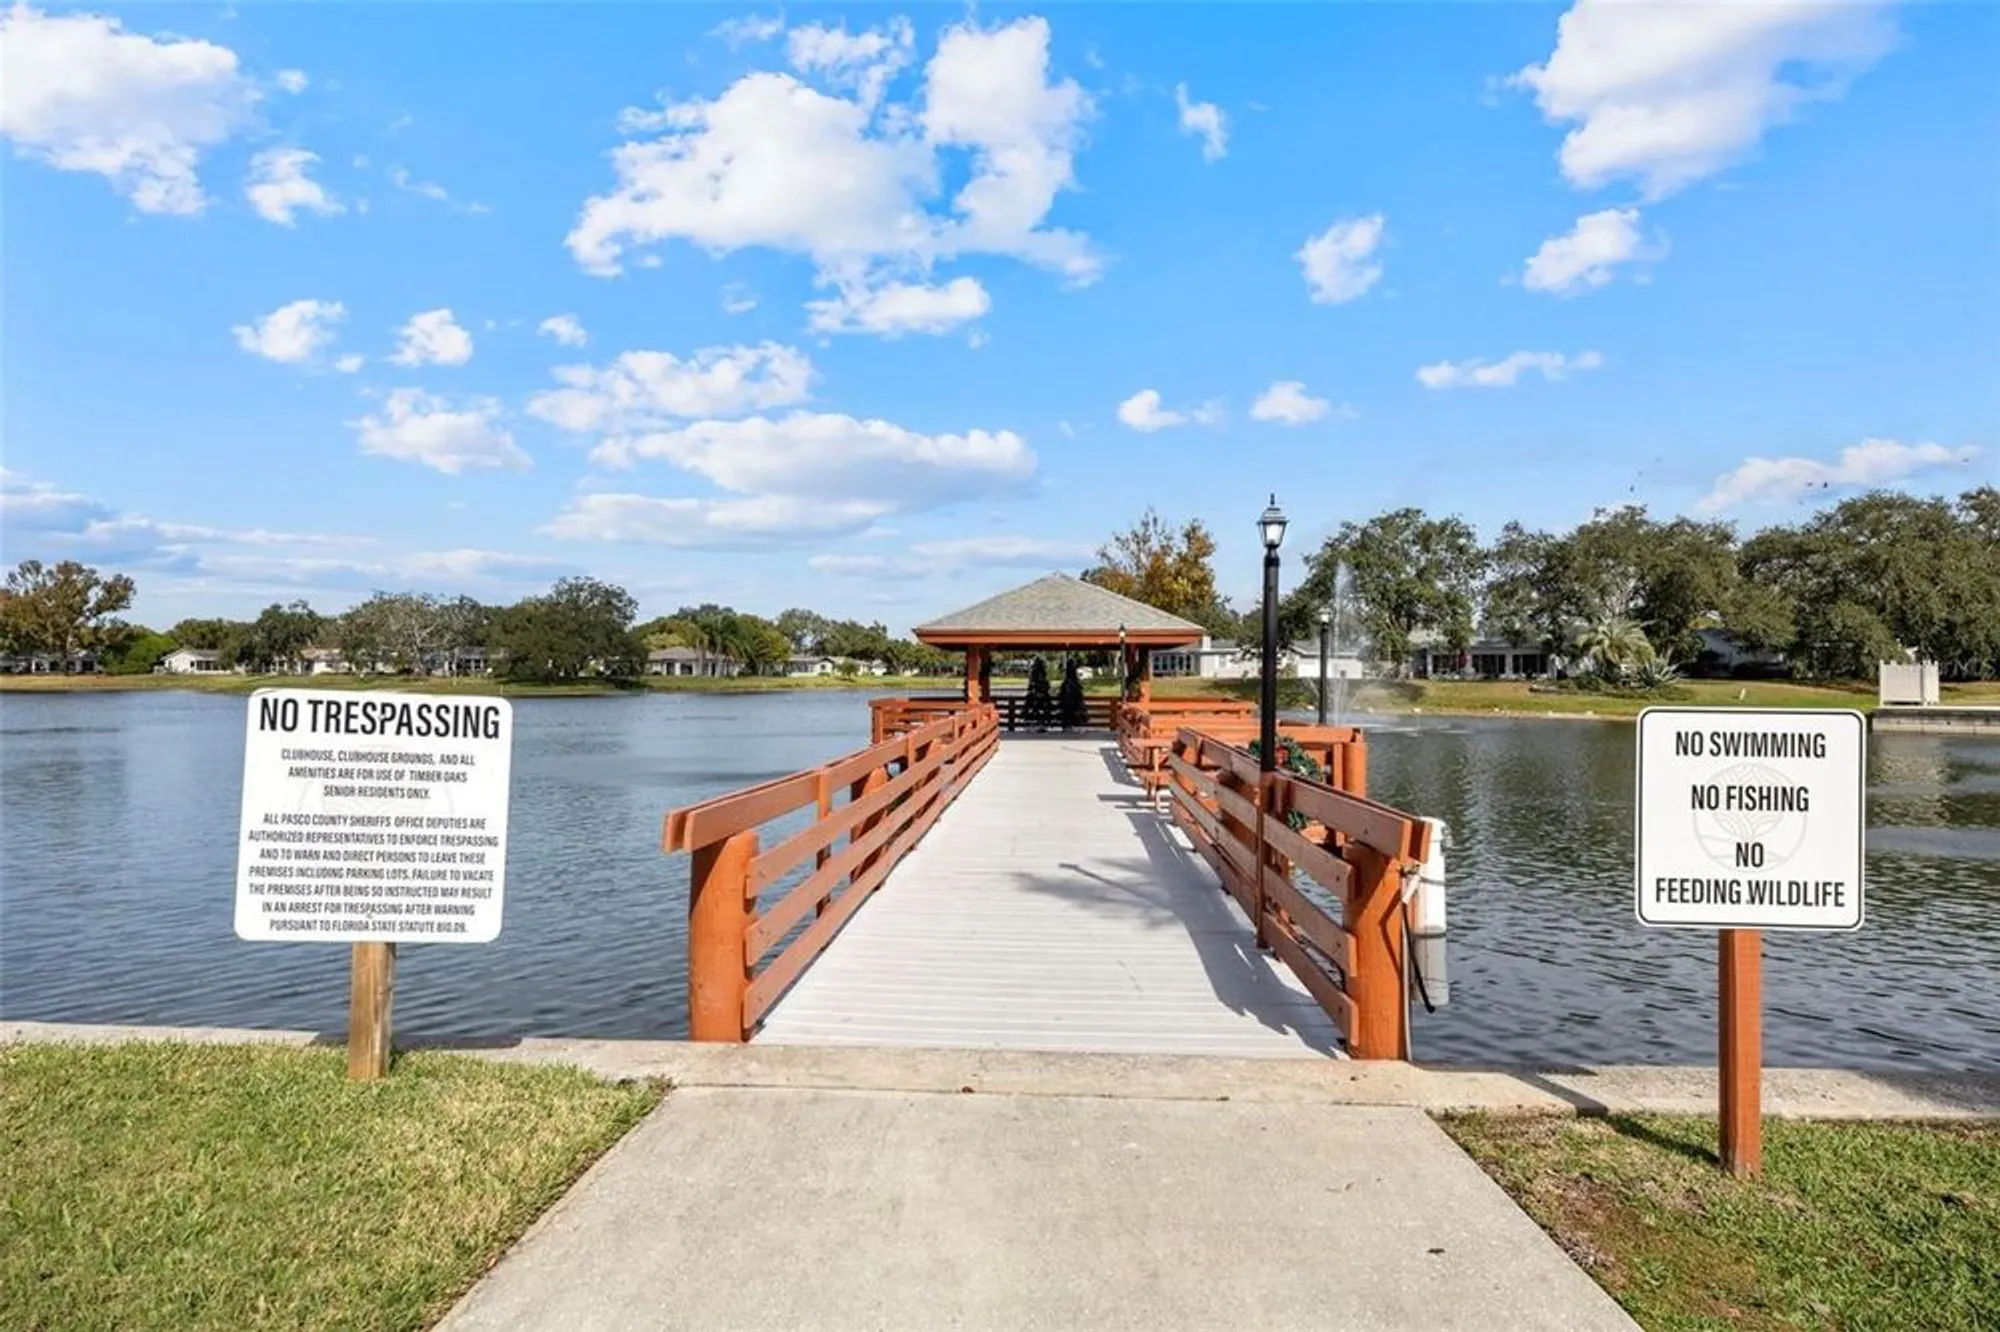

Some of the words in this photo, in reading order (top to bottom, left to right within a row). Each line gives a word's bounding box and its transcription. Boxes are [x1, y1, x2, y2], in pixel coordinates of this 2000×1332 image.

[259, 697, 299, 733] NO
[307, 699, 500, 740] TRESPASSING
[1675, 731, 1704, 757] NO
[1709, 731, 1826, 758] SWIMMING
[338, 750, 389, 763] CLUBHOUSE
[440, 753, 459, 765] AND
[460, 754, 476, 766] ALL
[288, 766, 336, 779] AMENITIES
[338, 767, 355, 779] ARE
[356, 768, 375, 780] FOR
[376, 769, 392, 781] USE
[394, 769, 405, 781] OF
[409, 770, 442, 783] TIMBER
[443, 771, 468, 783] OAKS
[323, 784, 356, 797] SENIOR
[357, 785, 405, 799] RESIDENTS
[1691, 785, 1720, 811] NO
[1726, 785, 1809, 812] FISHING
[263, 813, 279, 825] ALL
[281, 813, 311, 825] PASCO
[312, 814, 348, 826] COUNTY
[394, 816, 425, 828] OFFICE
[426, 817, 468, 829] DEPUTIES
[469, 818, 487, 830] ARE
[248, 830, 304, 842] AUTHORIZED
[305, 831, 385, 845] REPRESENTATIVES
[387, 833, 398, 845] TO
[400, 834, 438, 846] ENFORCE
[440, 835, 499, 847] TRESPASSING
[259, 848, 279, 860] AND
[280, 848, 292, 860] TO
[294, 849, 320, 860] WARN
[322, 850, 341, 861] AND
[342, 850, 375, 862] DIRECT
[376, 851, 417, 863] PERSONS
[418, 852, 429, 863] TO
[430, 852, 458, 863] LEAVE
[459, 852, 486, 865] THESE
[1735, 842, 1764, 868] NO
[248, 865, 294, 877] PREMISES
[295, 866, 344, 879] INCLUDING
[346, 867, 385, 880] PARKING
[412, 868, 448, 880] FAILURE
[449, 869, 461, 881] TO
[462, 870, 494, 881] VACATE
[248, 883, 265, 895] THE
[267, 884, 313, 896] PREMISES
[314, 884, 341, 896] AFTER
[343, 884, 370, 897] BEING
[371, 885, 383, 897] SO
[384, 886, 439, 898] INSTRUCTED
[440, 887, 459, 898] MAY
[460, 887, 493, 899] RESULT
[1655, 878, 1742, 905] FEEDING
[1747, 880, 1846, 907] WILDLIFE
[262, 901, 272, 913] IN
[274, 902, 287, 913] AN
[288, 902, 323, 913] ARREST
[324, 902, 342, 914] FOR
[343, 902, 403, 915] TRESPASSING
[404, 904, 432, 915] AFTER
[433, 904, 475, 916] WARNING
[269, 919, 318, 931] PURSUANT
[319, 920, 331, 931] TO
[332, 920, 370, 932] FLORIDA
[371, 921, 397, 932] STATE
[398, 921, 435, 933] STATUTE
